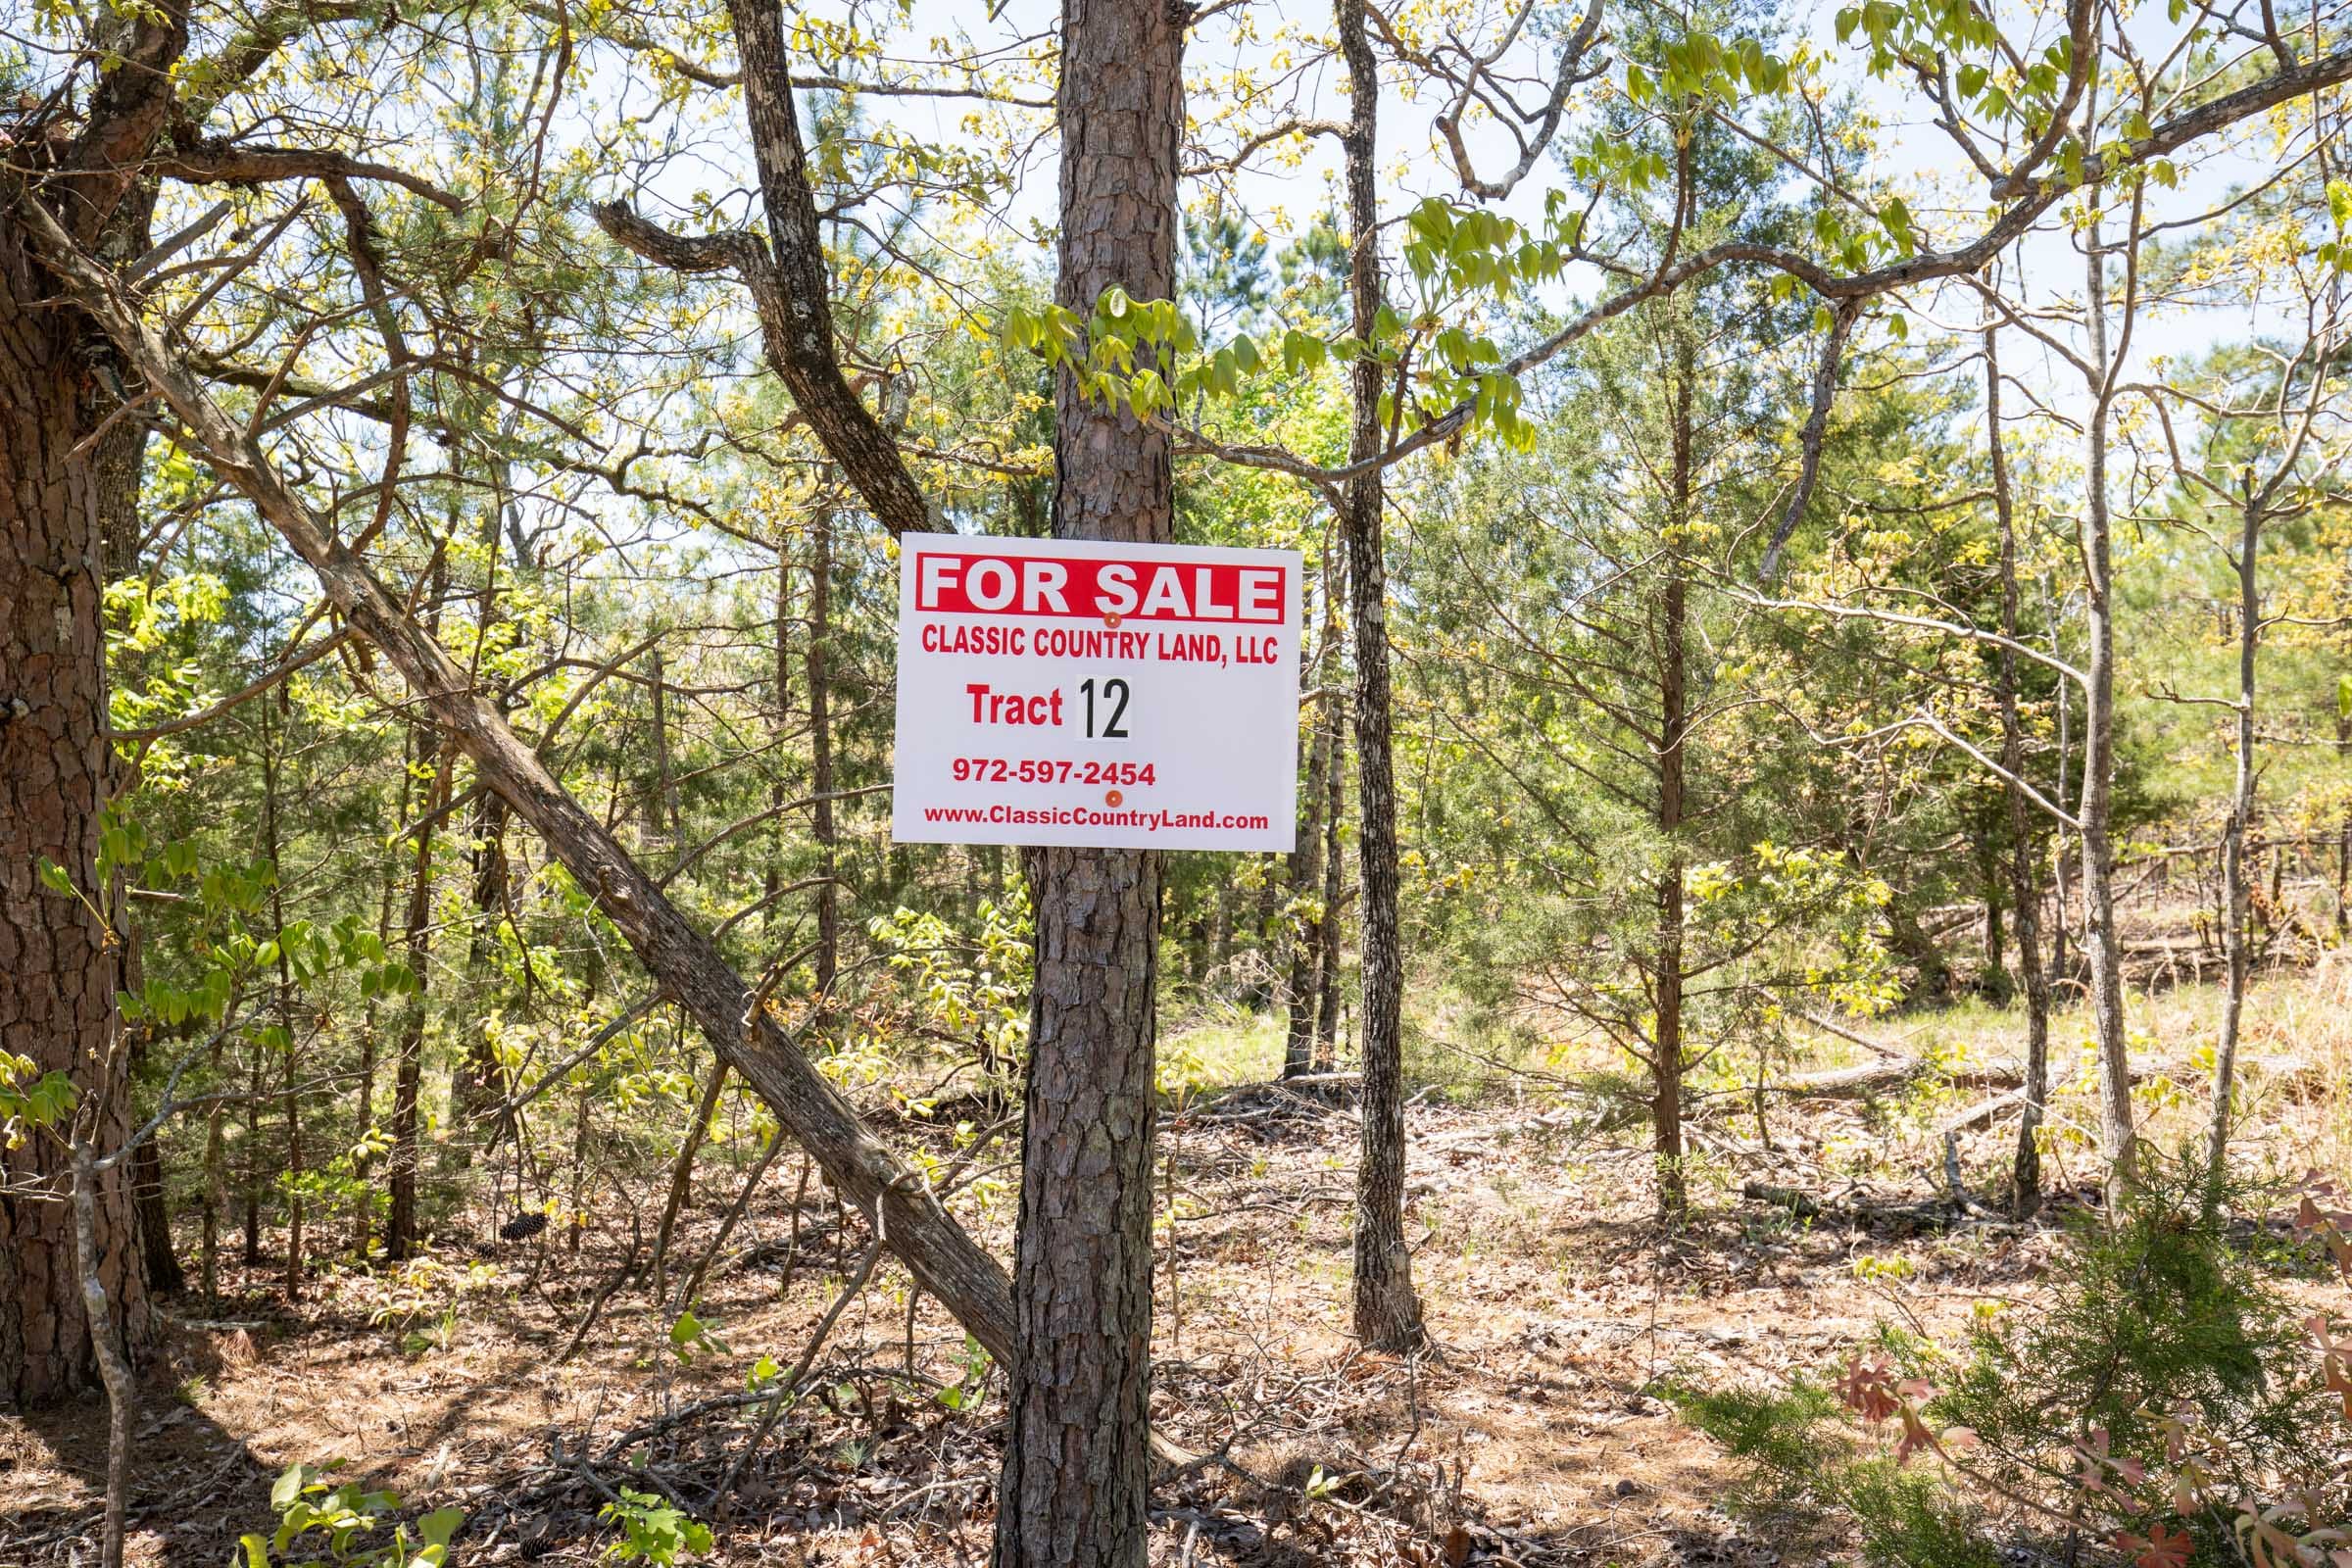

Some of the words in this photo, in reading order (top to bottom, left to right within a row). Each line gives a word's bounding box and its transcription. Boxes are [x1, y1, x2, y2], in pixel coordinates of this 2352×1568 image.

[921, 557, 1069, 612] FOR
[1095, 564, 1279, 620] SALE
[922, 624, 1025, 655] CLASSIC
[1034, 629, 1150, 660] COUNTRY
[1158, 634, 1227, 668] LAND,
[1236, 636, 1278, 663] LLC
[966, 683, 1063, 726] Tract
[1080, 678, 1130, 738] 12
[953, 759, 1155, 786] 972-597-2454
[925, 807, 1268, 830] www.ClassicCountryLand.com
